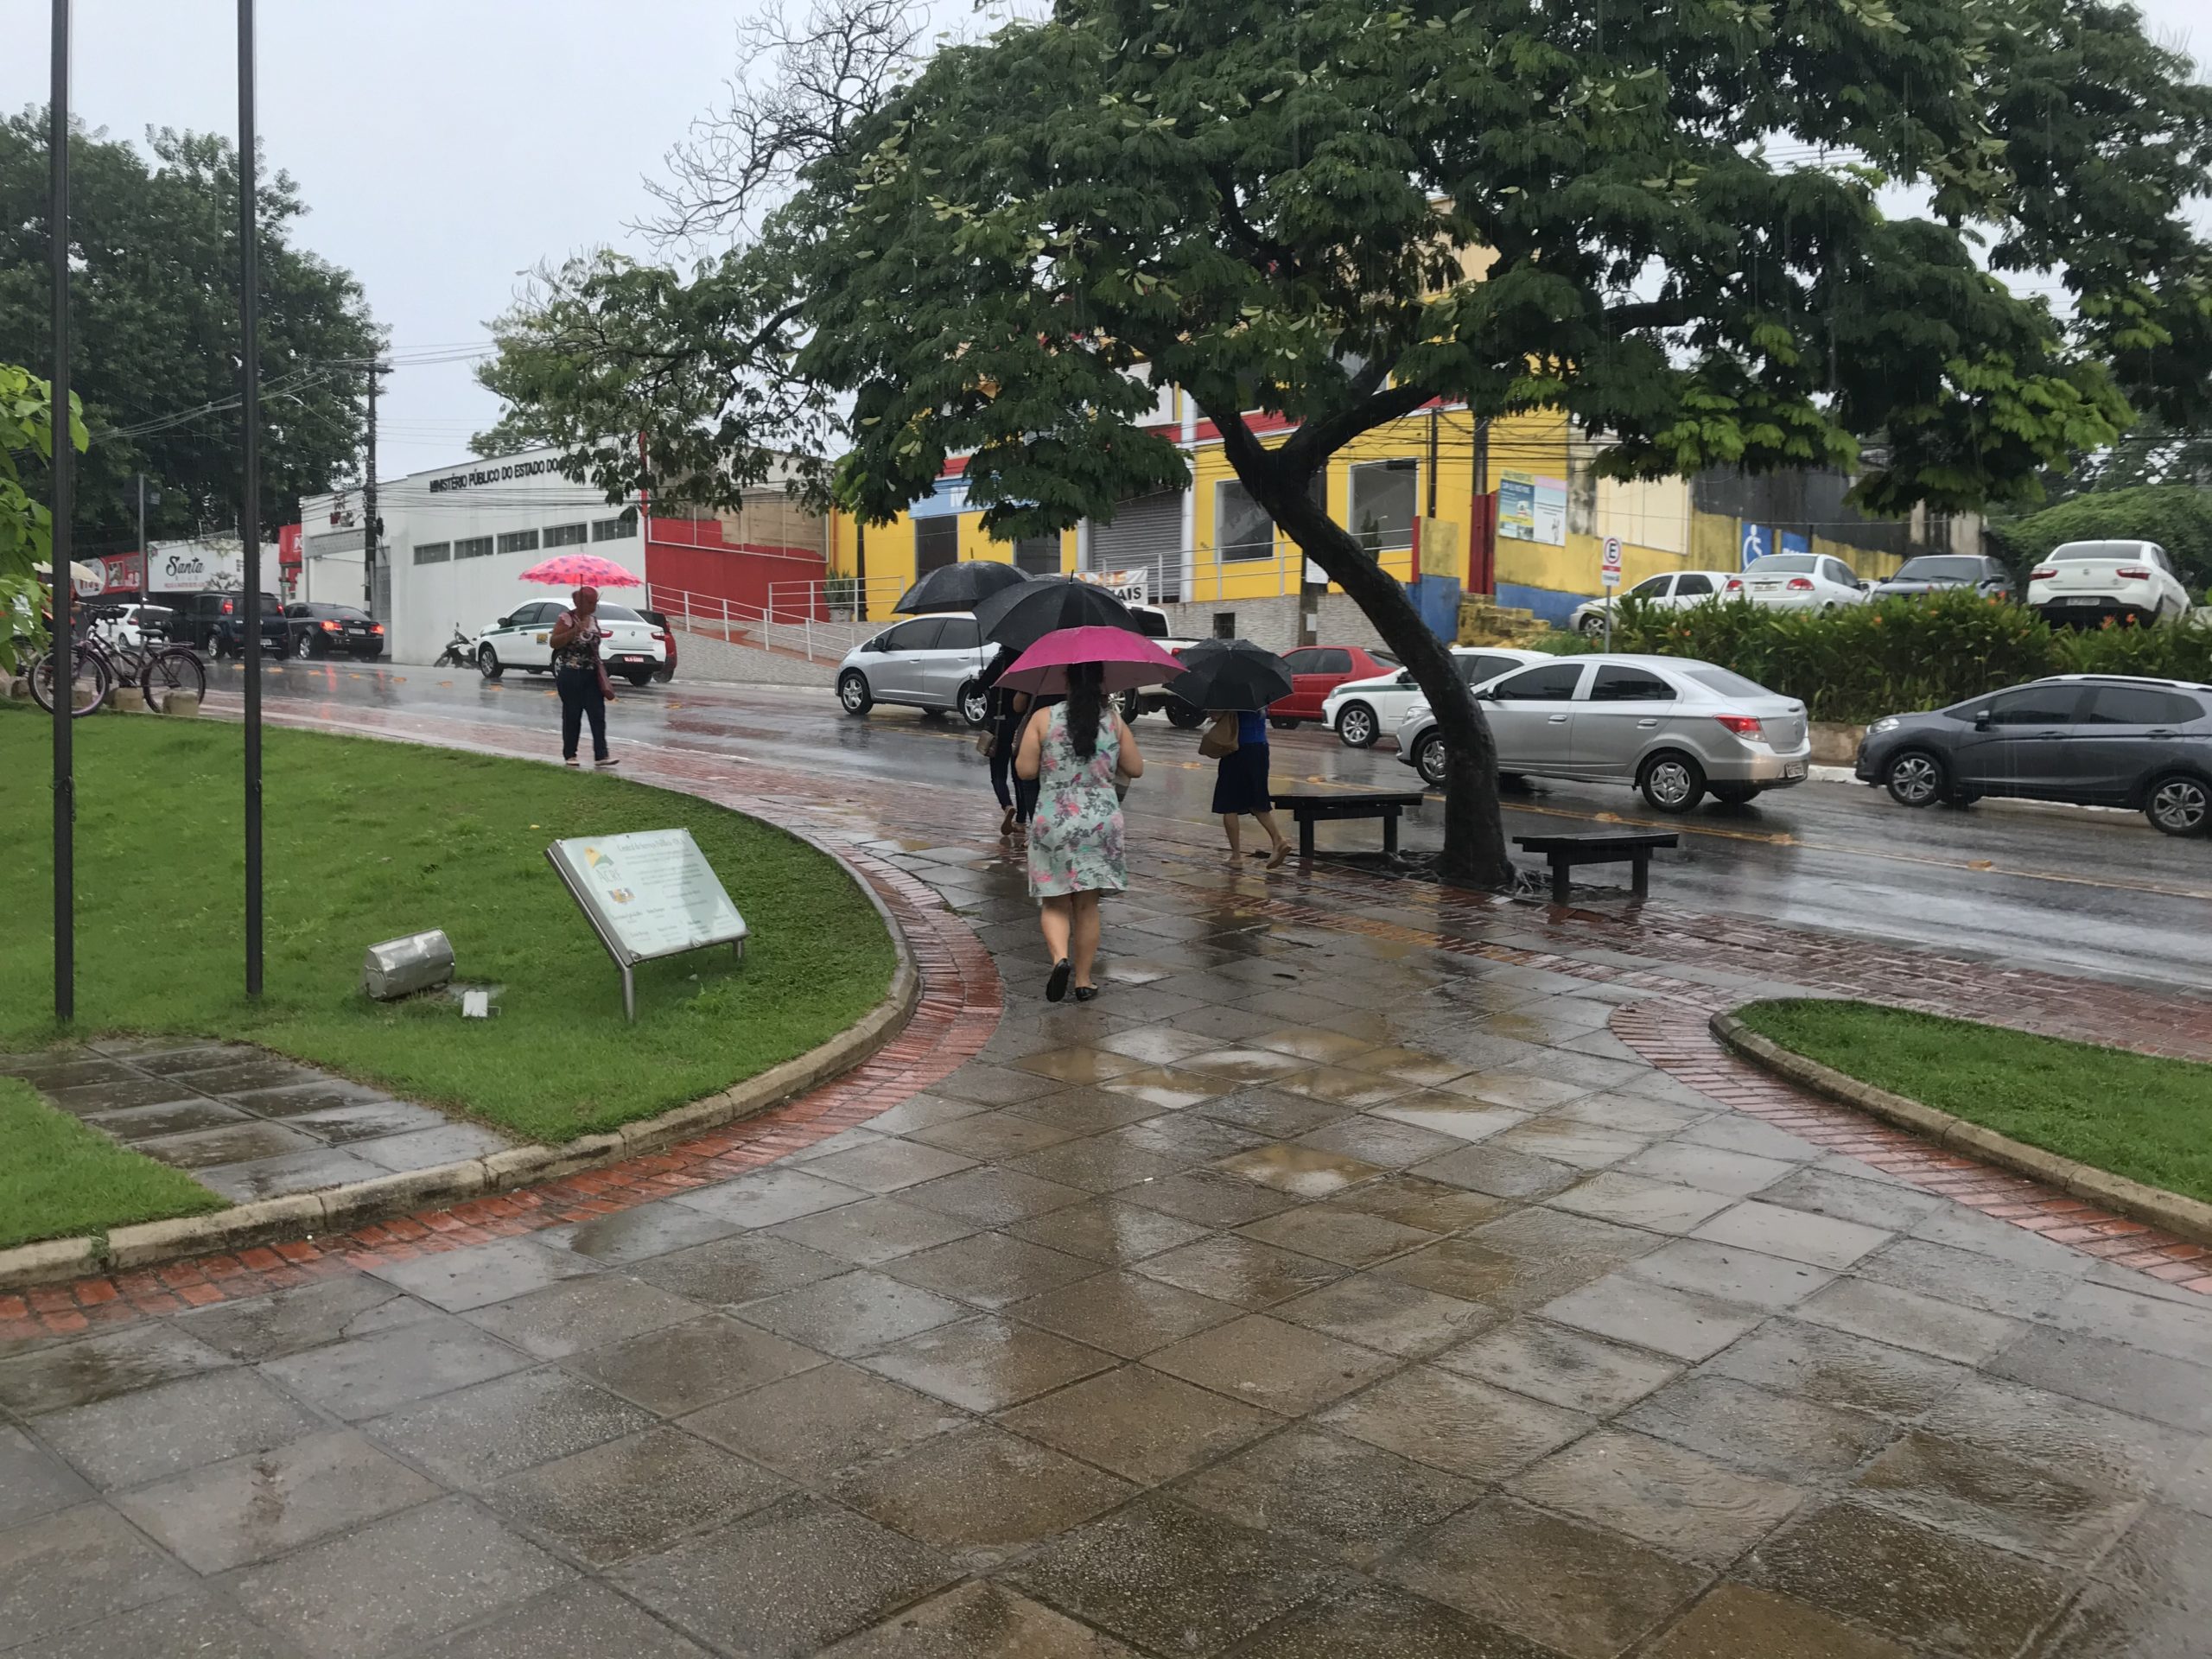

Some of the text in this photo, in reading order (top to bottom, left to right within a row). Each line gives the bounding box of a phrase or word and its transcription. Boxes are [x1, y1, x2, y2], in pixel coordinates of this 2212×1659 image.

[429, 458, 558, 493] MINISTÉRIO PÚBLICO DO ESTADO DO
[1609, 543, 1617, 559] E
[166, 556, 204, 576] Santa
